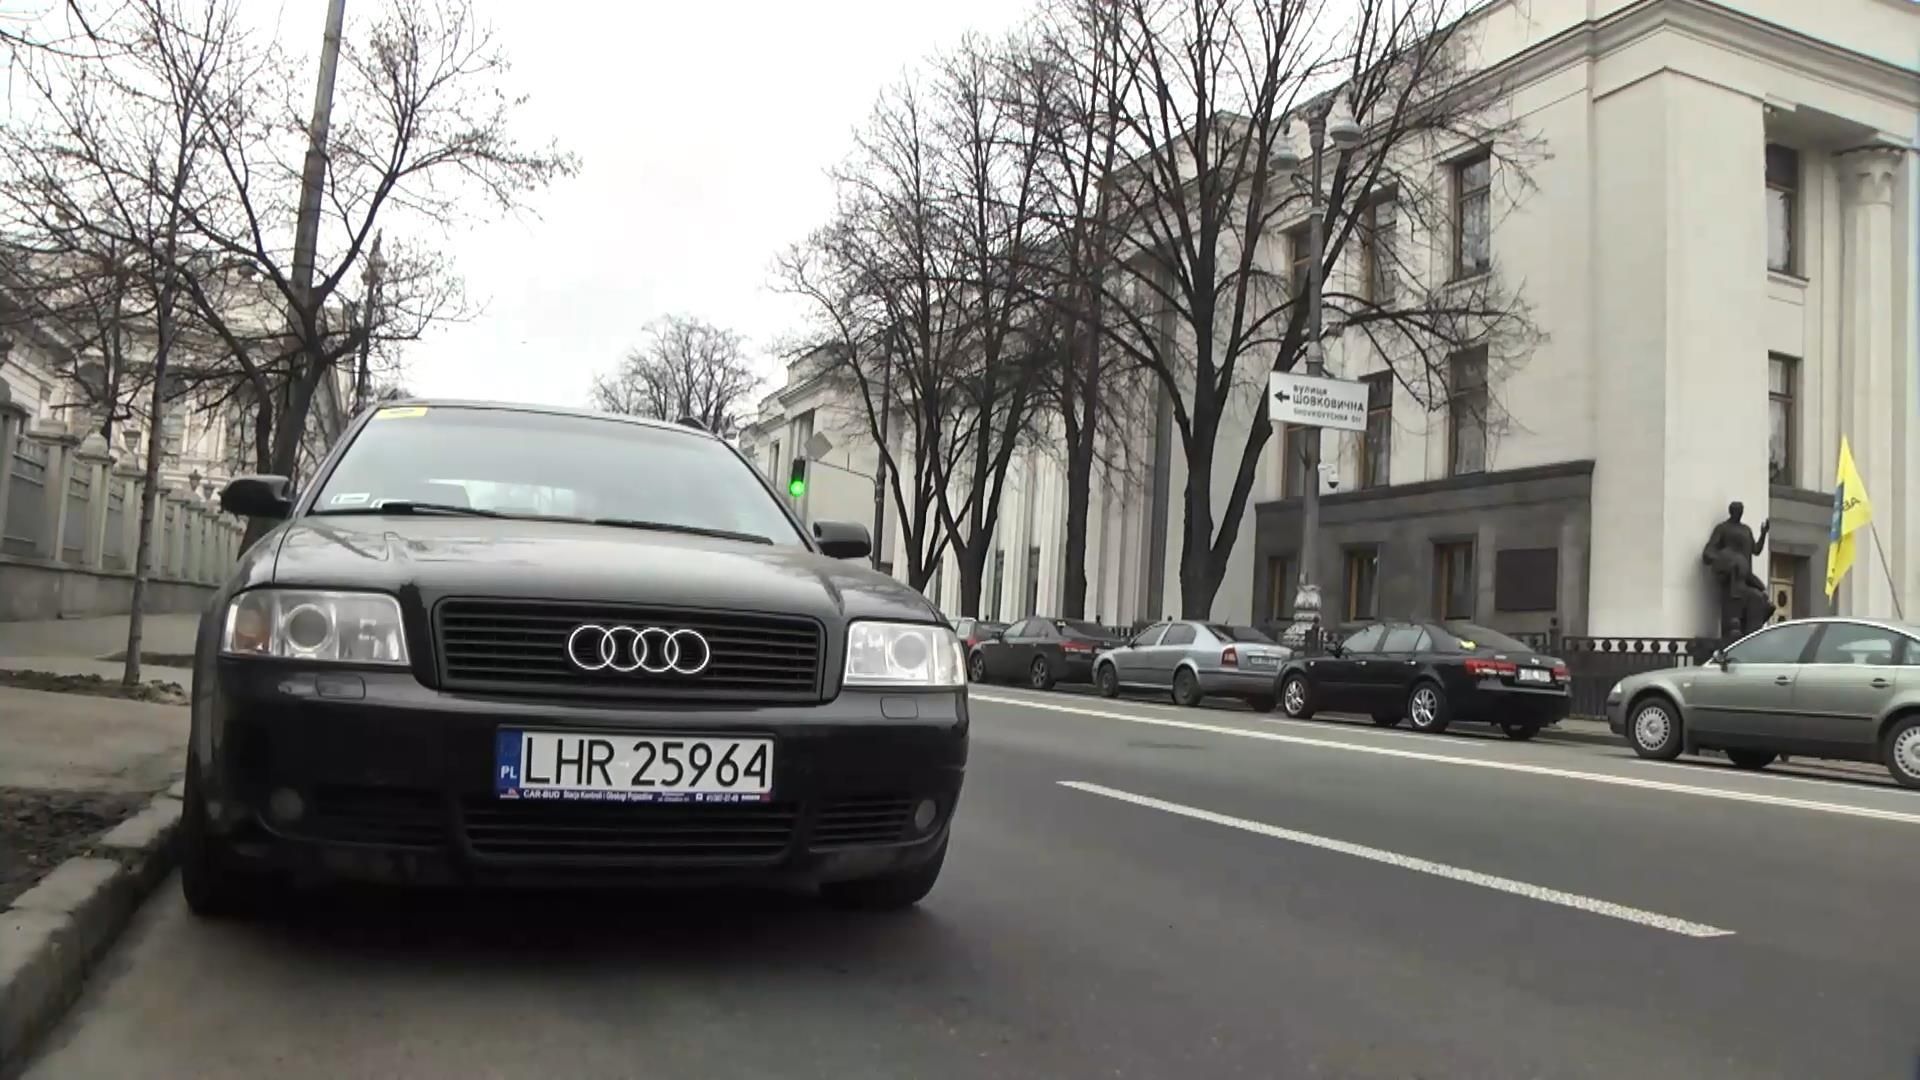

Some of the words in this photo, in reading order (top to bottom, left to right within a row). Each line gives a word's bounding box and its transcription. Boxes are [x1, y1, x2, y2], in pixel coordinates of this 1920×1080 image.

[1293, 395, 1365, 412] ШОВКОВИЧНА
[525, 736, 614, 787] LHR
[630, 740, 769, 789] 25964
[500, 765, 518, 780] PL
